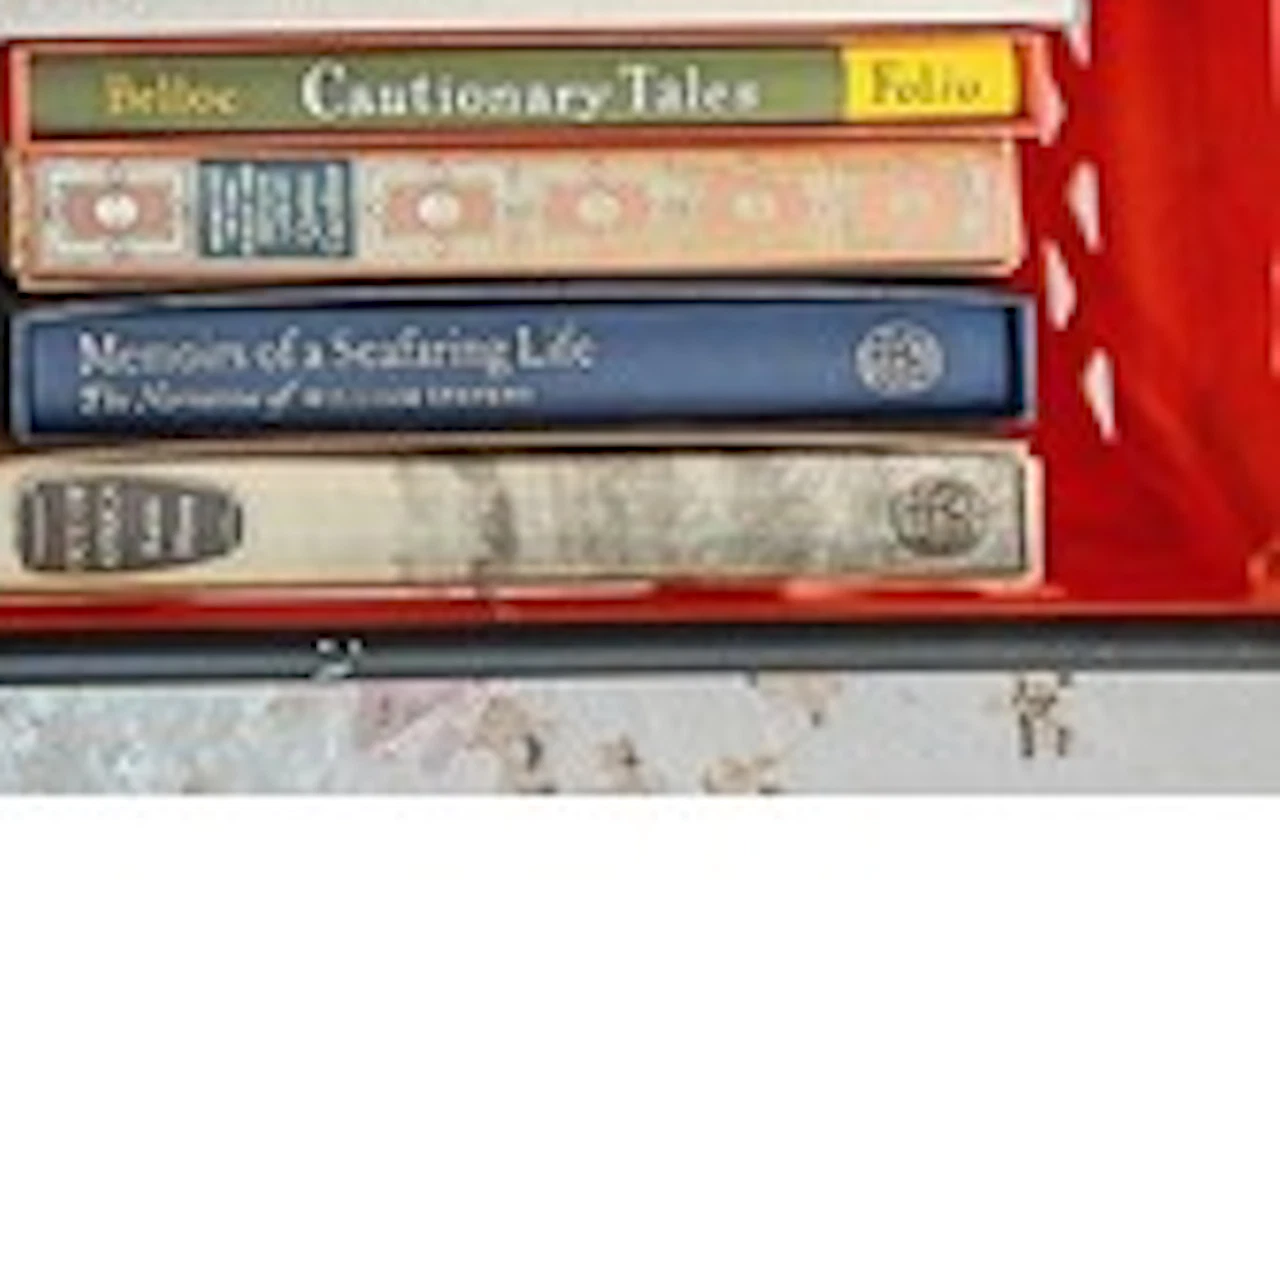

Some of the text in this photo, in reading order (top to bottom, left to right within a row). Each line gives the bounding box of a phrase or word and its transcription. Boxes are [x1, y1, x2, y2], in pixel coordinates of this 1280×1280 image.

[104, 63, 984, 126] Belloc Cautionary Tales Folio
[515, 323, 596, 371] Life
